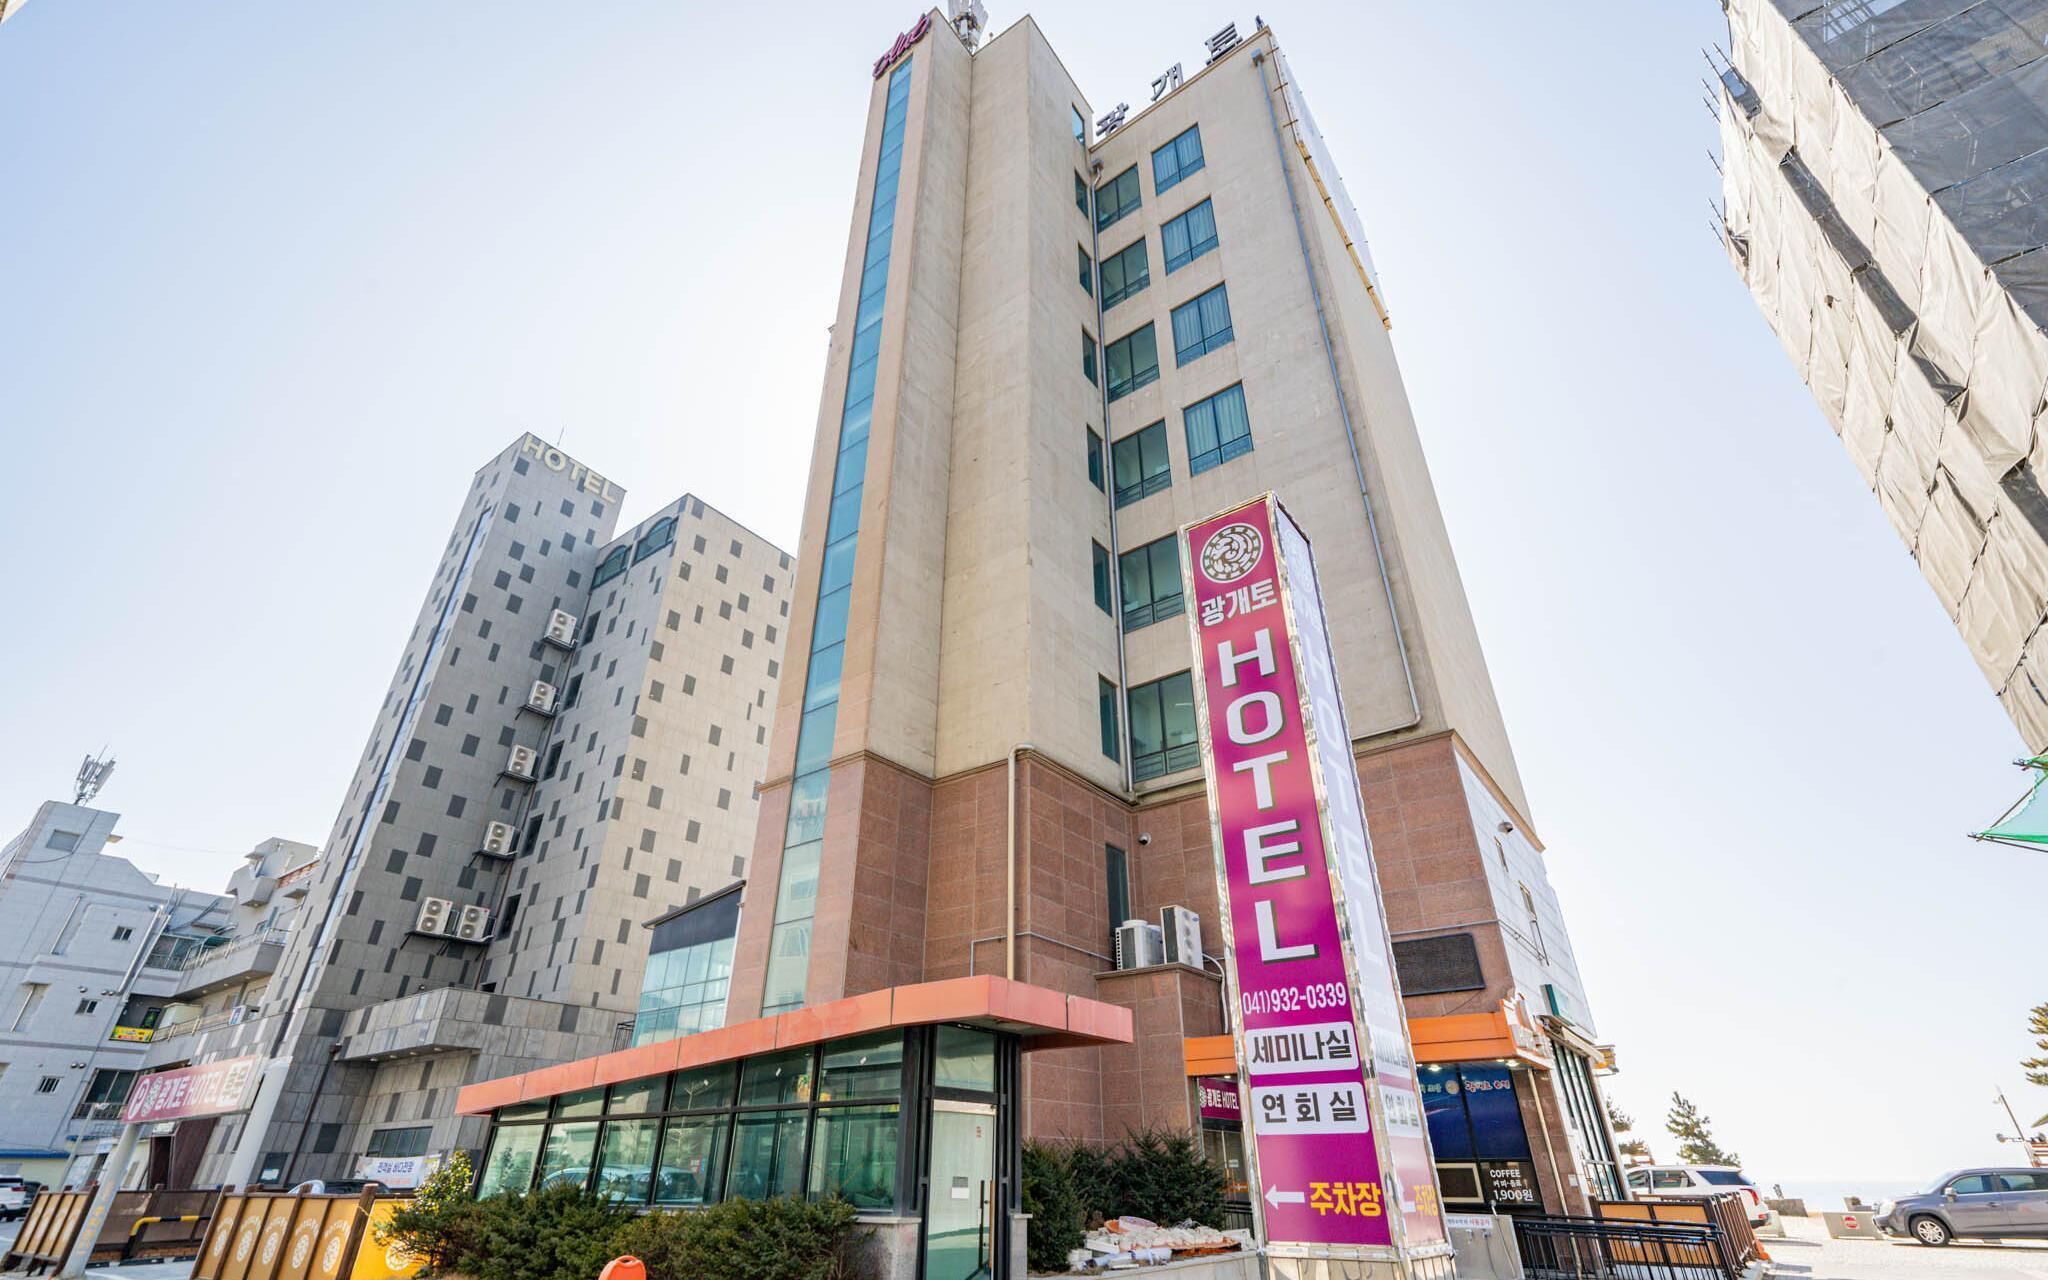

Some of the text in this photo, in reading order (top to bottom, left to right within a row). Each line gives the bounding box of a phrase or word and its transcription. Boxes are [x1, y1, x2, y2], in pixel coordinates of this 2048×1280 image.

[522, 434, 616, 504] HOTEL
[1201, 577, 1278, 627] 광개토
[1217, 627, 1317, 962] HOTEL
[1242, 981, 1347, 1015] 041)932-0339
[1252, 1029, 1352, 1065] 세미나실
[1222, 1091, 1240, 1110] HOTEL
[1490, 1169, 1521, 1178] COFFEE
[1309, 1182, 1382, 1218] 주차장
[1493, 1189, 1534, 1202] 1,900원
